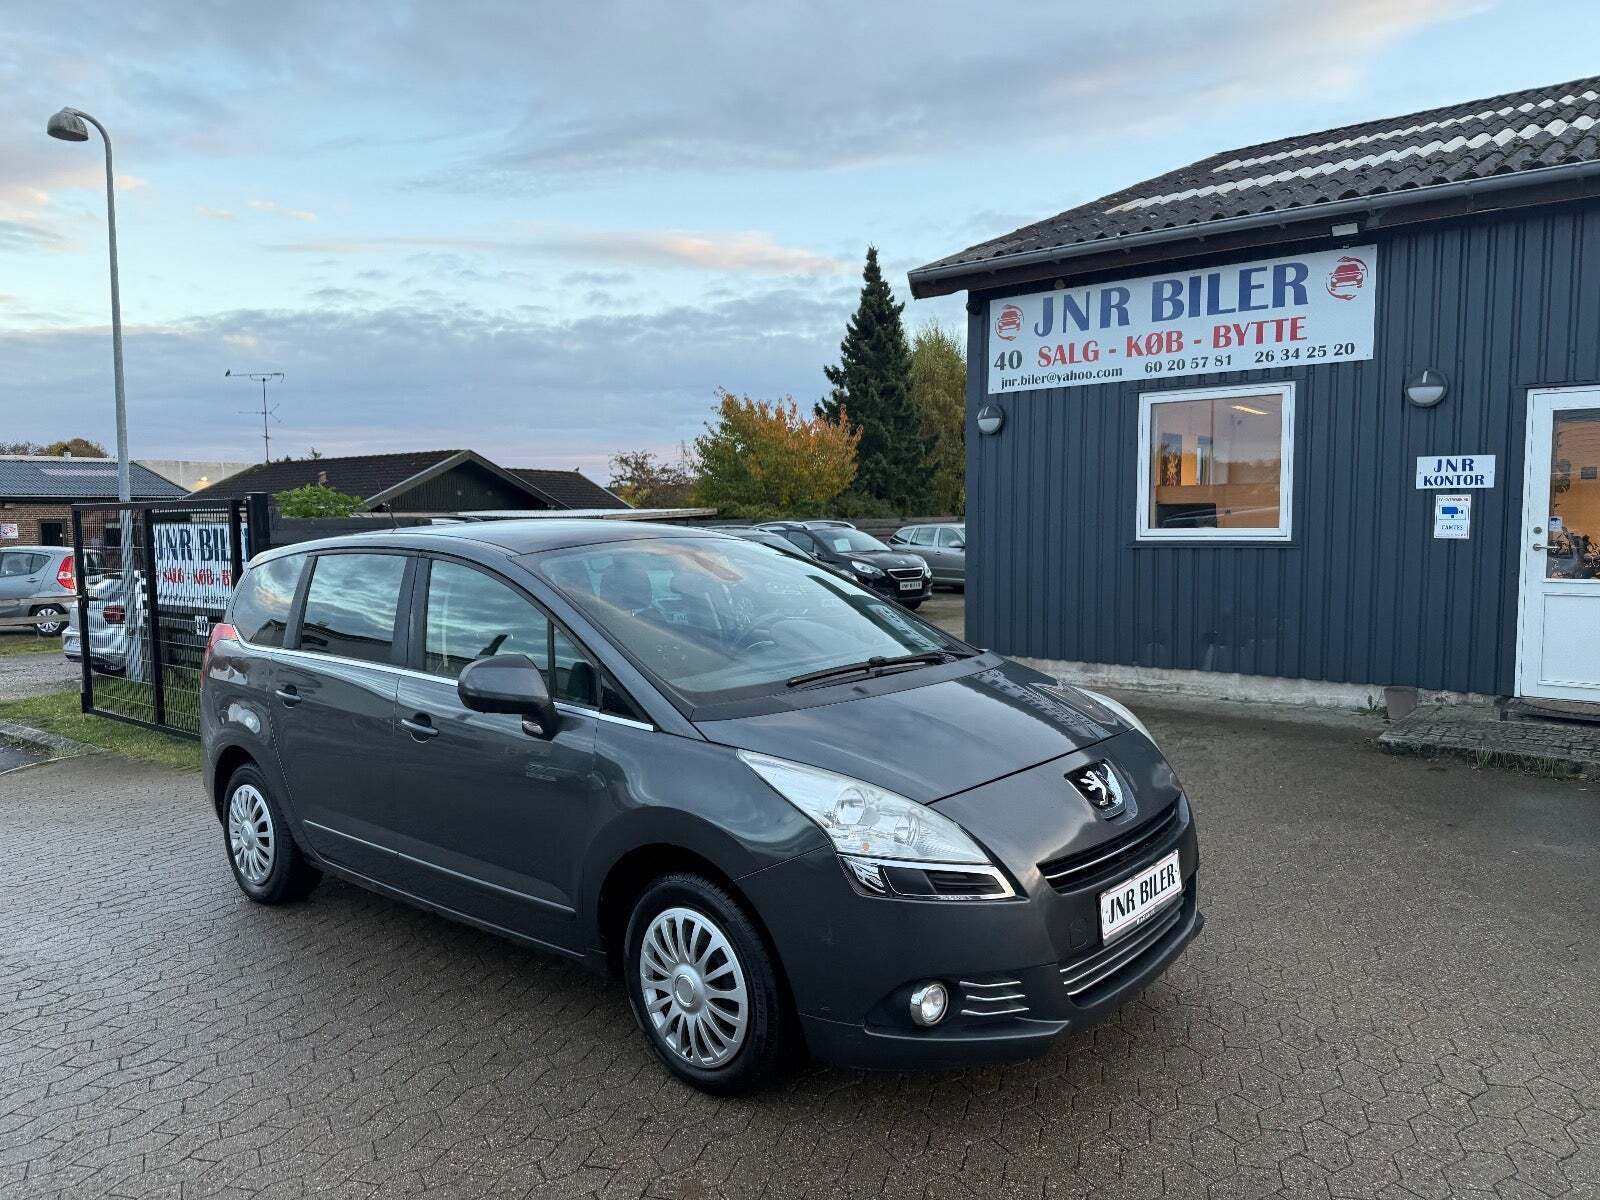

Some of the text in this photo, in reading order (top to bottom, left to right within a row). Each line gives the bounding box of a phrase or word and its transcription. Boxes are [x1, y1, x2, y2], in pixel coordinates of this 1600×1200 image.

[1034, 262, 1309, 338] JNR BILER
[1038, 340, 1100, 368] SALG
[1125, 329, 1184, 358] KØB
[1212, 316, 1308, 349] BYTTE
[1144, 342, 1355, 374] 60 20 57 81 26 34 25 20
[994, 349, 1023, 371] 40
[1001, 367, 1123, 391] jnr.biler@yahoo.com
[1423, 474, 1485, 487] KONTOR
[1433, 458, 1475, 473] JNR
[157, 527, 194, 561] JNR
[1108, 887, 1136, 924] JNR
[1139, 863, 1176, 906] BILER
